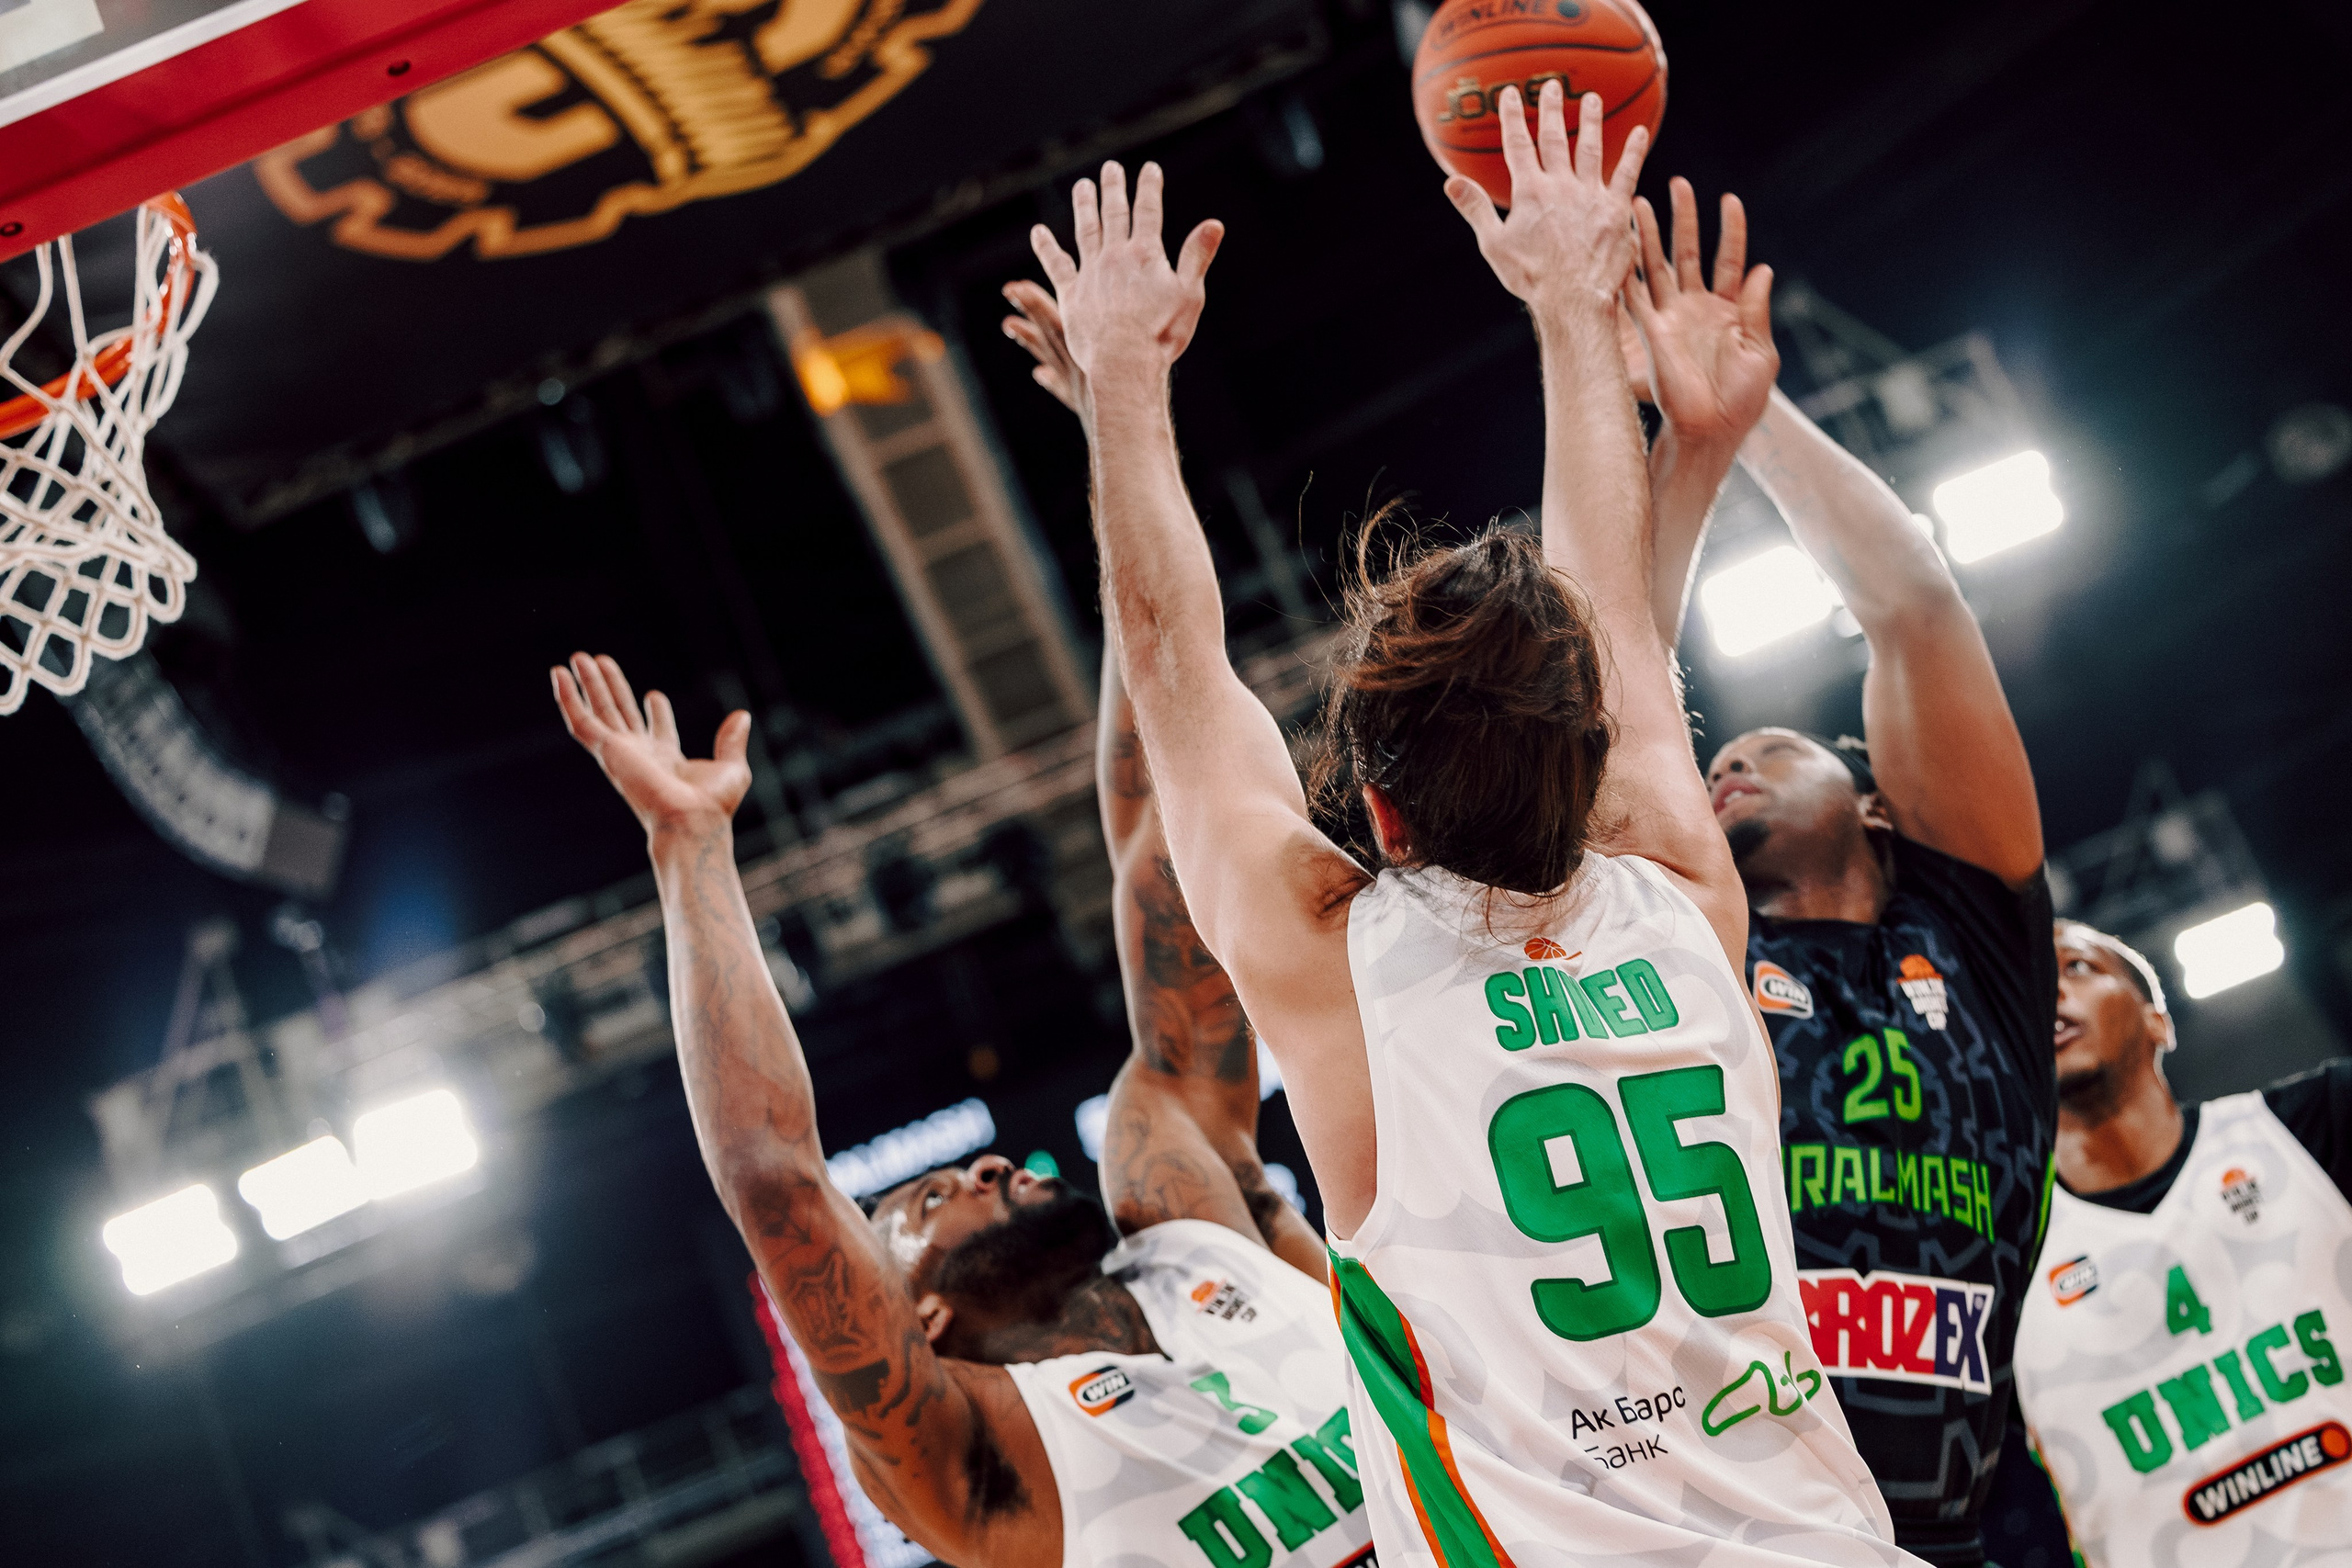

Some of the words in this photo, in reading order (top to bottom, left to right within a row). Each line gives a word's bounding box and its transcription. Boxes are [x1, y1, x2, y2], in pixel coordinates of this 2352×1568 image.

[1768, 978, 1807, 1005] WIN
[1843, 1028, 1921, 1124] 25
[1487, 1065, 1773, 1342] 95
[1781, 1143, 1996, 1244] RALMASH
[2165, 1264, 2212, 1335] 4
[1085, 1372, 1128, 1402] WIN
[1571, 1407, 1615, 1439] Ак
[1614, 1385, 1686, 1424] Барс
[2101, 1309, 2345, 1474] UNICS
[2195, 1436, 2324, 1522] WINLINE
